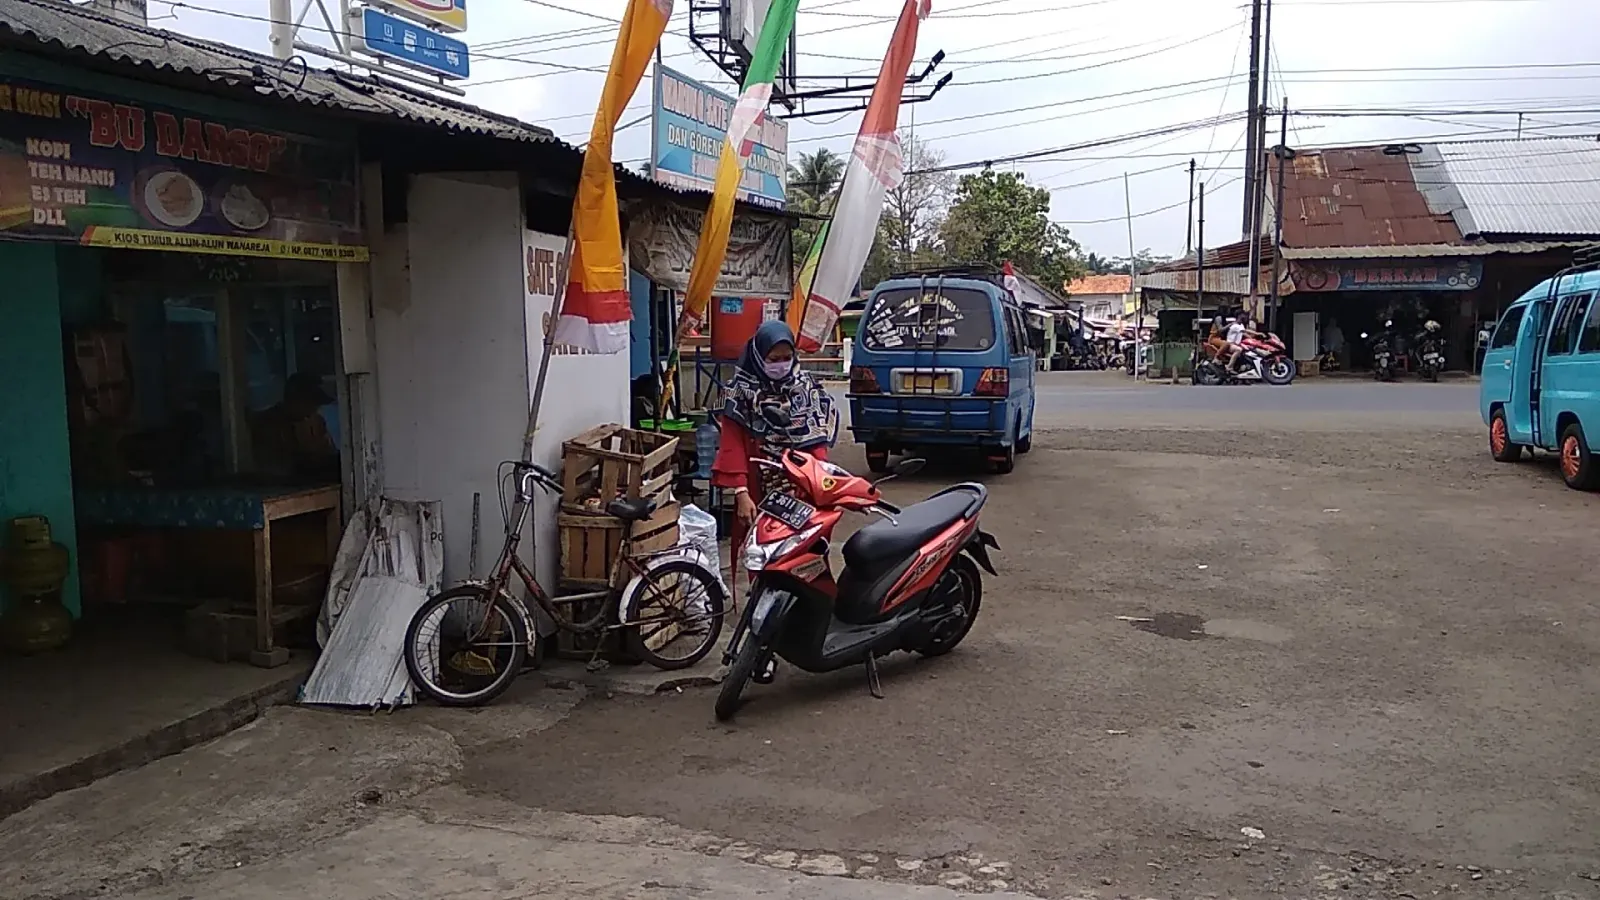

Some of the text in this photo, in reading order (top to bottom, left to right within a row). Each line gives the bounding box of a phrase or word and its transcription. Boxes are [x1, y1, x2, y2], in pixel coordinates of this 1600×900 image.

[668, 123, 687, 149] DAN
[26, 138, 71, 160] KOPI
[27, 161, 116, 187] TEH MANIS
[31, 185, 86, 205] ES TEH
[33, 207, 66, 226] DLL
[114, 232, 140, 243] KIOS
[143, 234, 173, 246] TIMUR
[174, 237, 226, 249] ALUN-ALUN
[227, 240, 271, 253] WANAREJA
[526, 245, 554, 296] SATE
